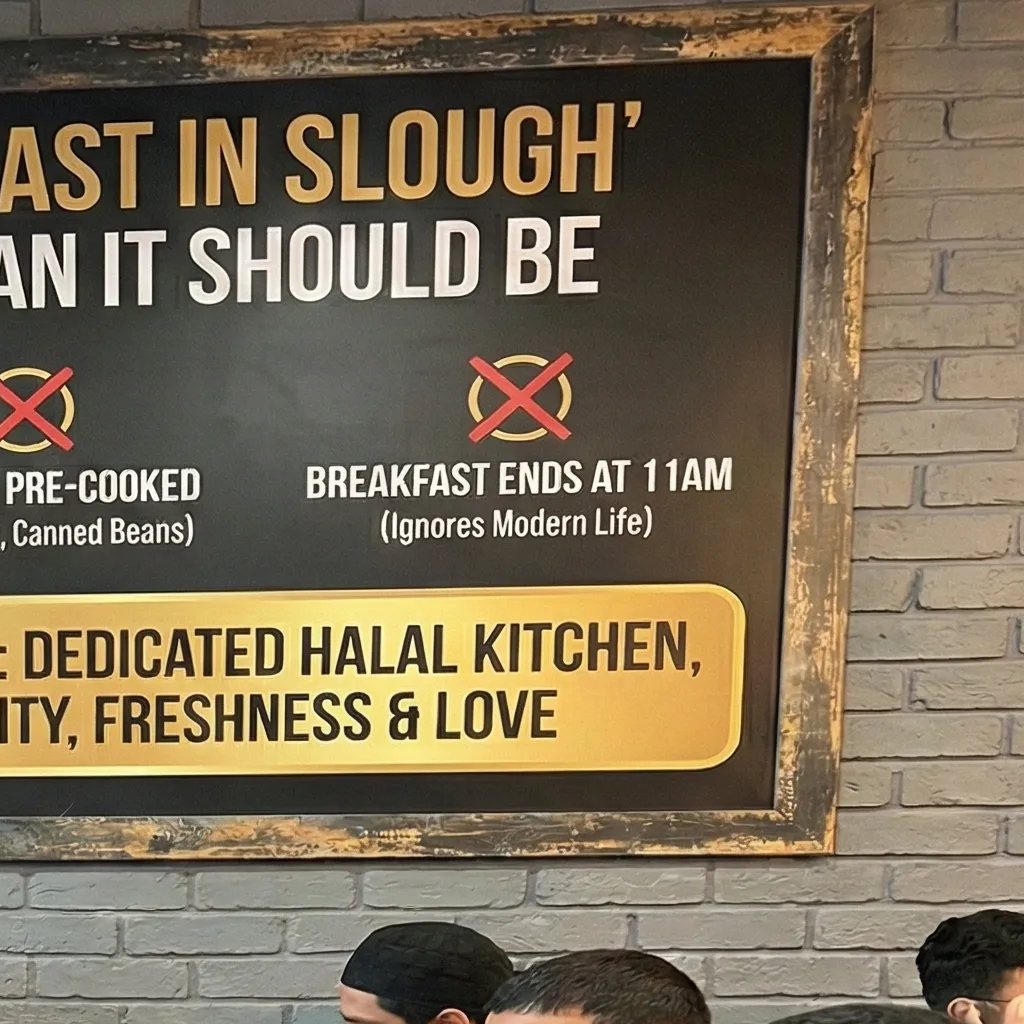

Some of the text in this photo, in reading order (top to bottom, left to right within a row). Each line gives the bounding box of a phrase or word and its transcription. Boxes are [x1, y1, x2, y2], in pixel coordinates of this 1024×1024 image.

[179, 116, 258, 208] IN
[103, 229, 167, 308] IT
[188, 219, 479, 305] SHOULD
[505, 215, 601, 297] BE
[4, 467, 201, 505] PRE-COOKED
[305, 457, 733, 500] BREAKFAST ENDS AT 11AM
[12, 518, 103, 548] Canned
[110, 513, 195, 547] Beans)
[380, 505, 653, 546] (Ignores Modern Life)
[23, 625, 284, 680] DEDICATED
[301, 623, 458, 677] HALAL
[474, 620, 701, 678] KITCHEN,
[95, 690, 372, 745] FRESHNESS
[388, 691, 419, 741] &
[435, 689, 558, 741] LOVE
